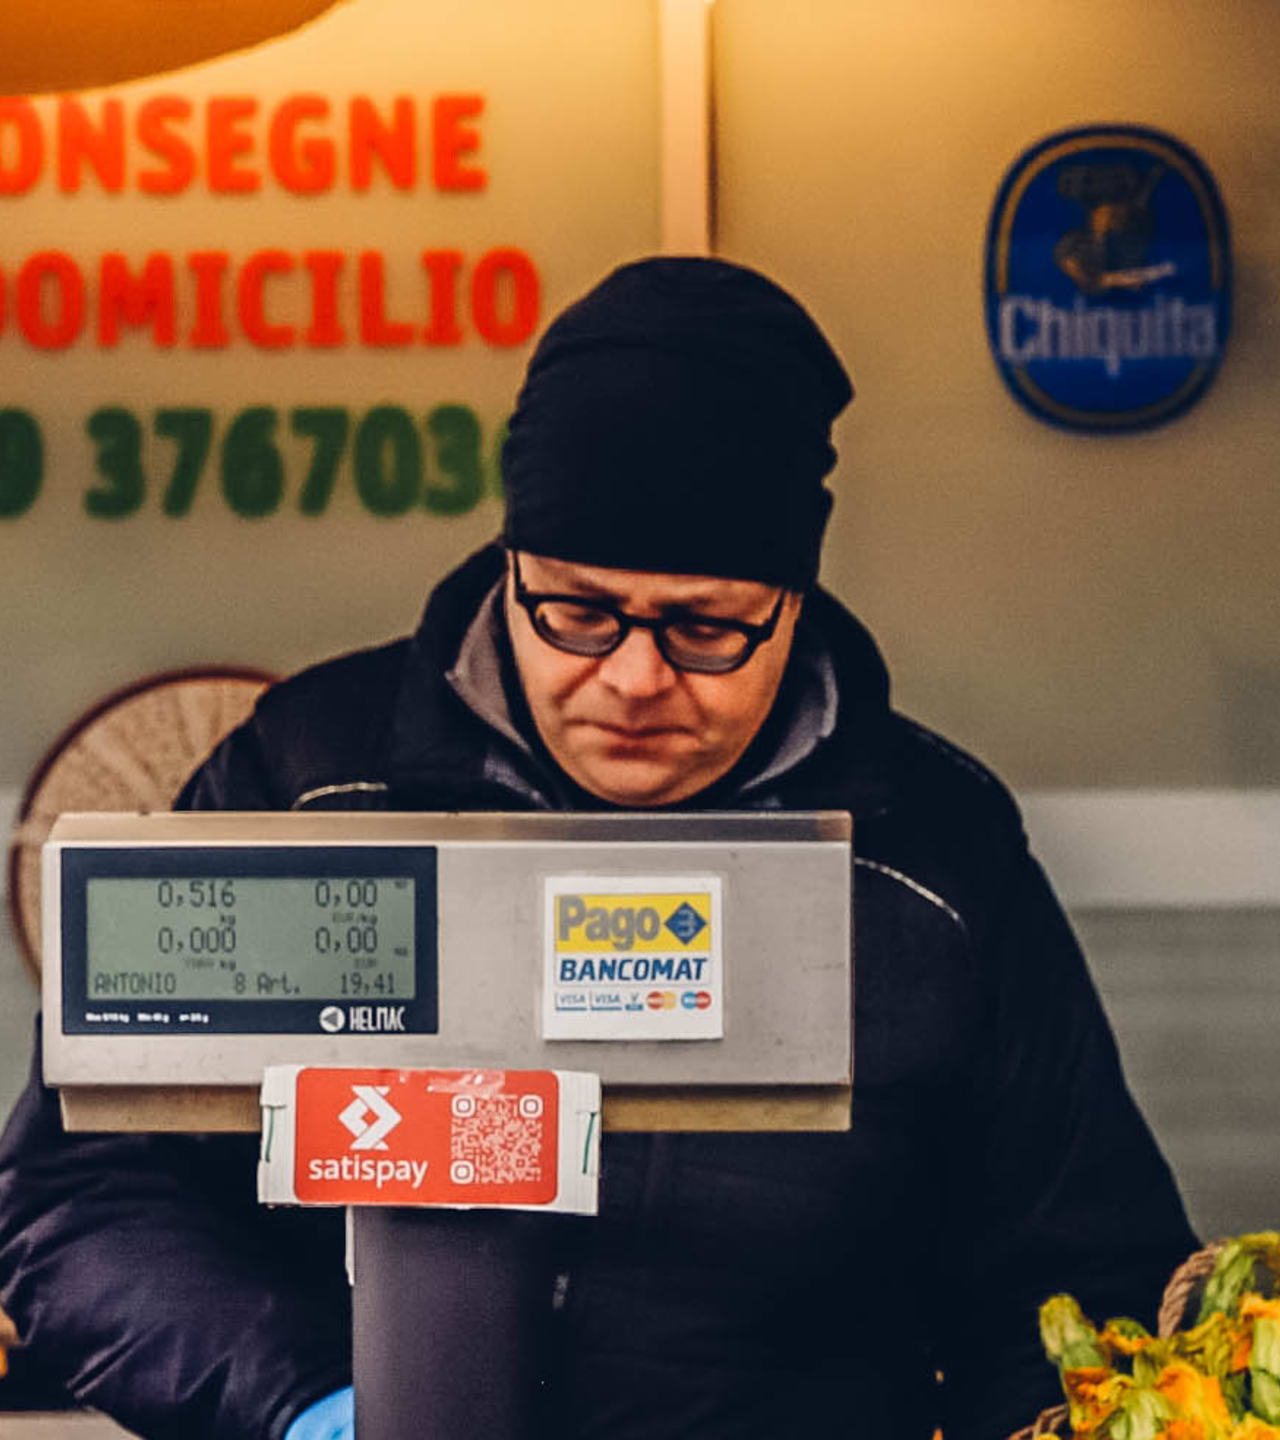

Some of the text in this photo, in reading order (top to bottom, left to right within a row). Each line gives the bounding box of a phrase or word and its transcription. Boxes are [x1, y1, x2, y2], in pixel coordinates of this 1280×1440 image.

[998, 293, 1217, 377] Chiquita
[83, 402, 510, 522] 376703
[157, 880, 237, 909] 0,516
[315, 879, 378, 908] 0,00
[559, 893, 661, 952] Pago
[157, 925, 237, 955] 0,000
[315, 926, 378, 954] 0,00
[93, 972, 396, 996] ANTONIO 8 Art. 19,41
[559, 957, 708, 982] BANCOMAT
[308, 1154, 429, 1190] satispay
